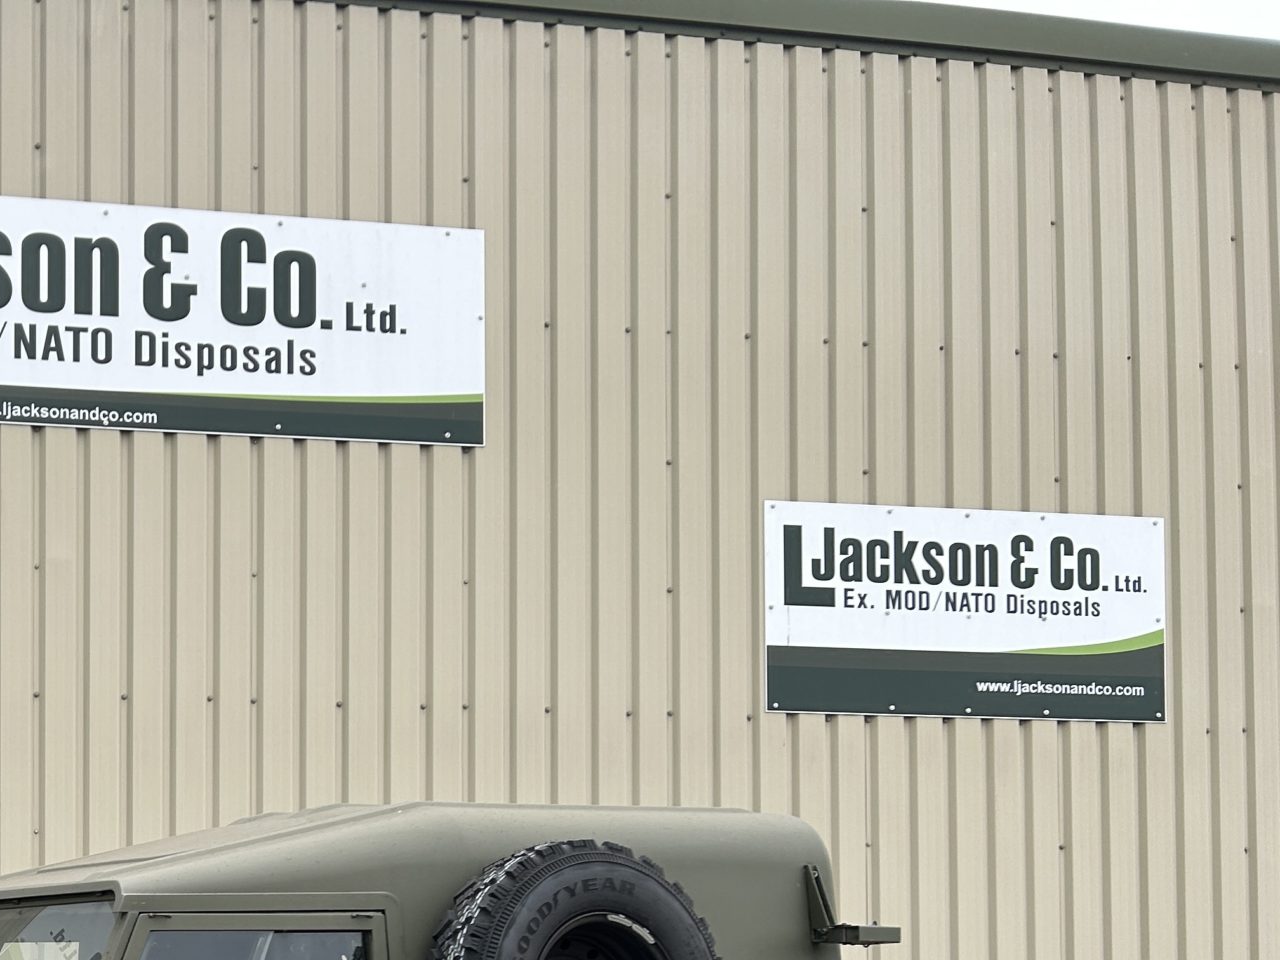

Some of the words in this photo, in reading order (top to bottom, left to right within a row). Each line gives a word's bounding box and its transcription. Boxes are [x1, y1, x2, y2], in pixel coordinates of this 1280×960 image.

[142, 222, 198, 323] &
[220, 227, 333, 330] Co.
[345, 301, 408, 335] Ltd.
[134, 330, 318, 377] Disposals
[1010, 534, 1039, 590] &
[1049, 535, 1109, 592] Co.
[1114, 575, 1148, 593] Ltd.
[843, 587, 875, 610] Ex.
[885, 589, 996, 614] MOD/NATO
[1006, 593, 1101, 619] Disposals
[976, 679, 1145, 697] www.ljacksonandco.com
